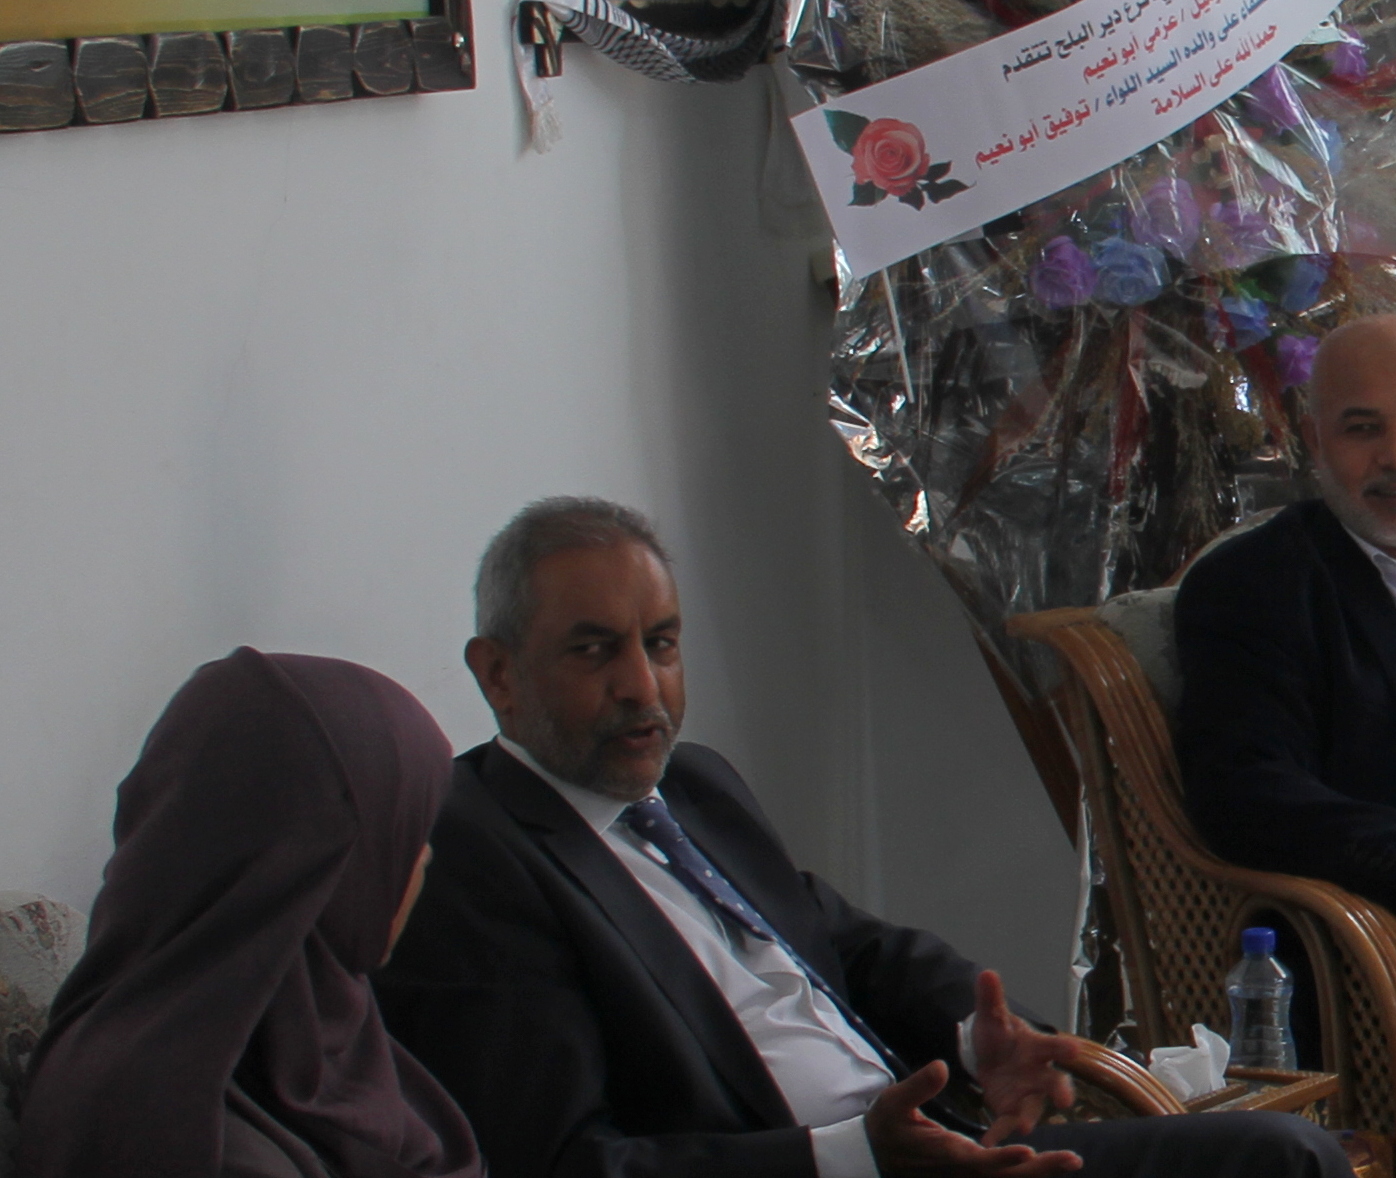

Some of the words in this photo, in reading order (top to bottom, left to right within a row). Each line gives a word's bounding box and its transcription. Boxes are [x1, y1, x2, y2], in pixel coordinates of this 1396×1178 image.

[1099, 9, 1122, 38] دير
[1124, 0, 1150, 23] رع
[1217, 13, 1240, 42] على
[1055, 21, 1094, 60] البلح
[1144, 15, 1178, 53] عزمي
[1184, 29, 1216, 59] والده
[1002, 40, 1053, 82] تتقدم
[1082, 47, 1118, 85] نعيم
[1145, 47, 1183, 84] السيد
[1209, 58, 1234, 88] على
[1105, 72, 1142, 107] اللواء
[1151, 71, 1206, 115] السلامة
[1042, 98, 1091, 140] توفيق
[975, 133, 1015, 170] نعيم
